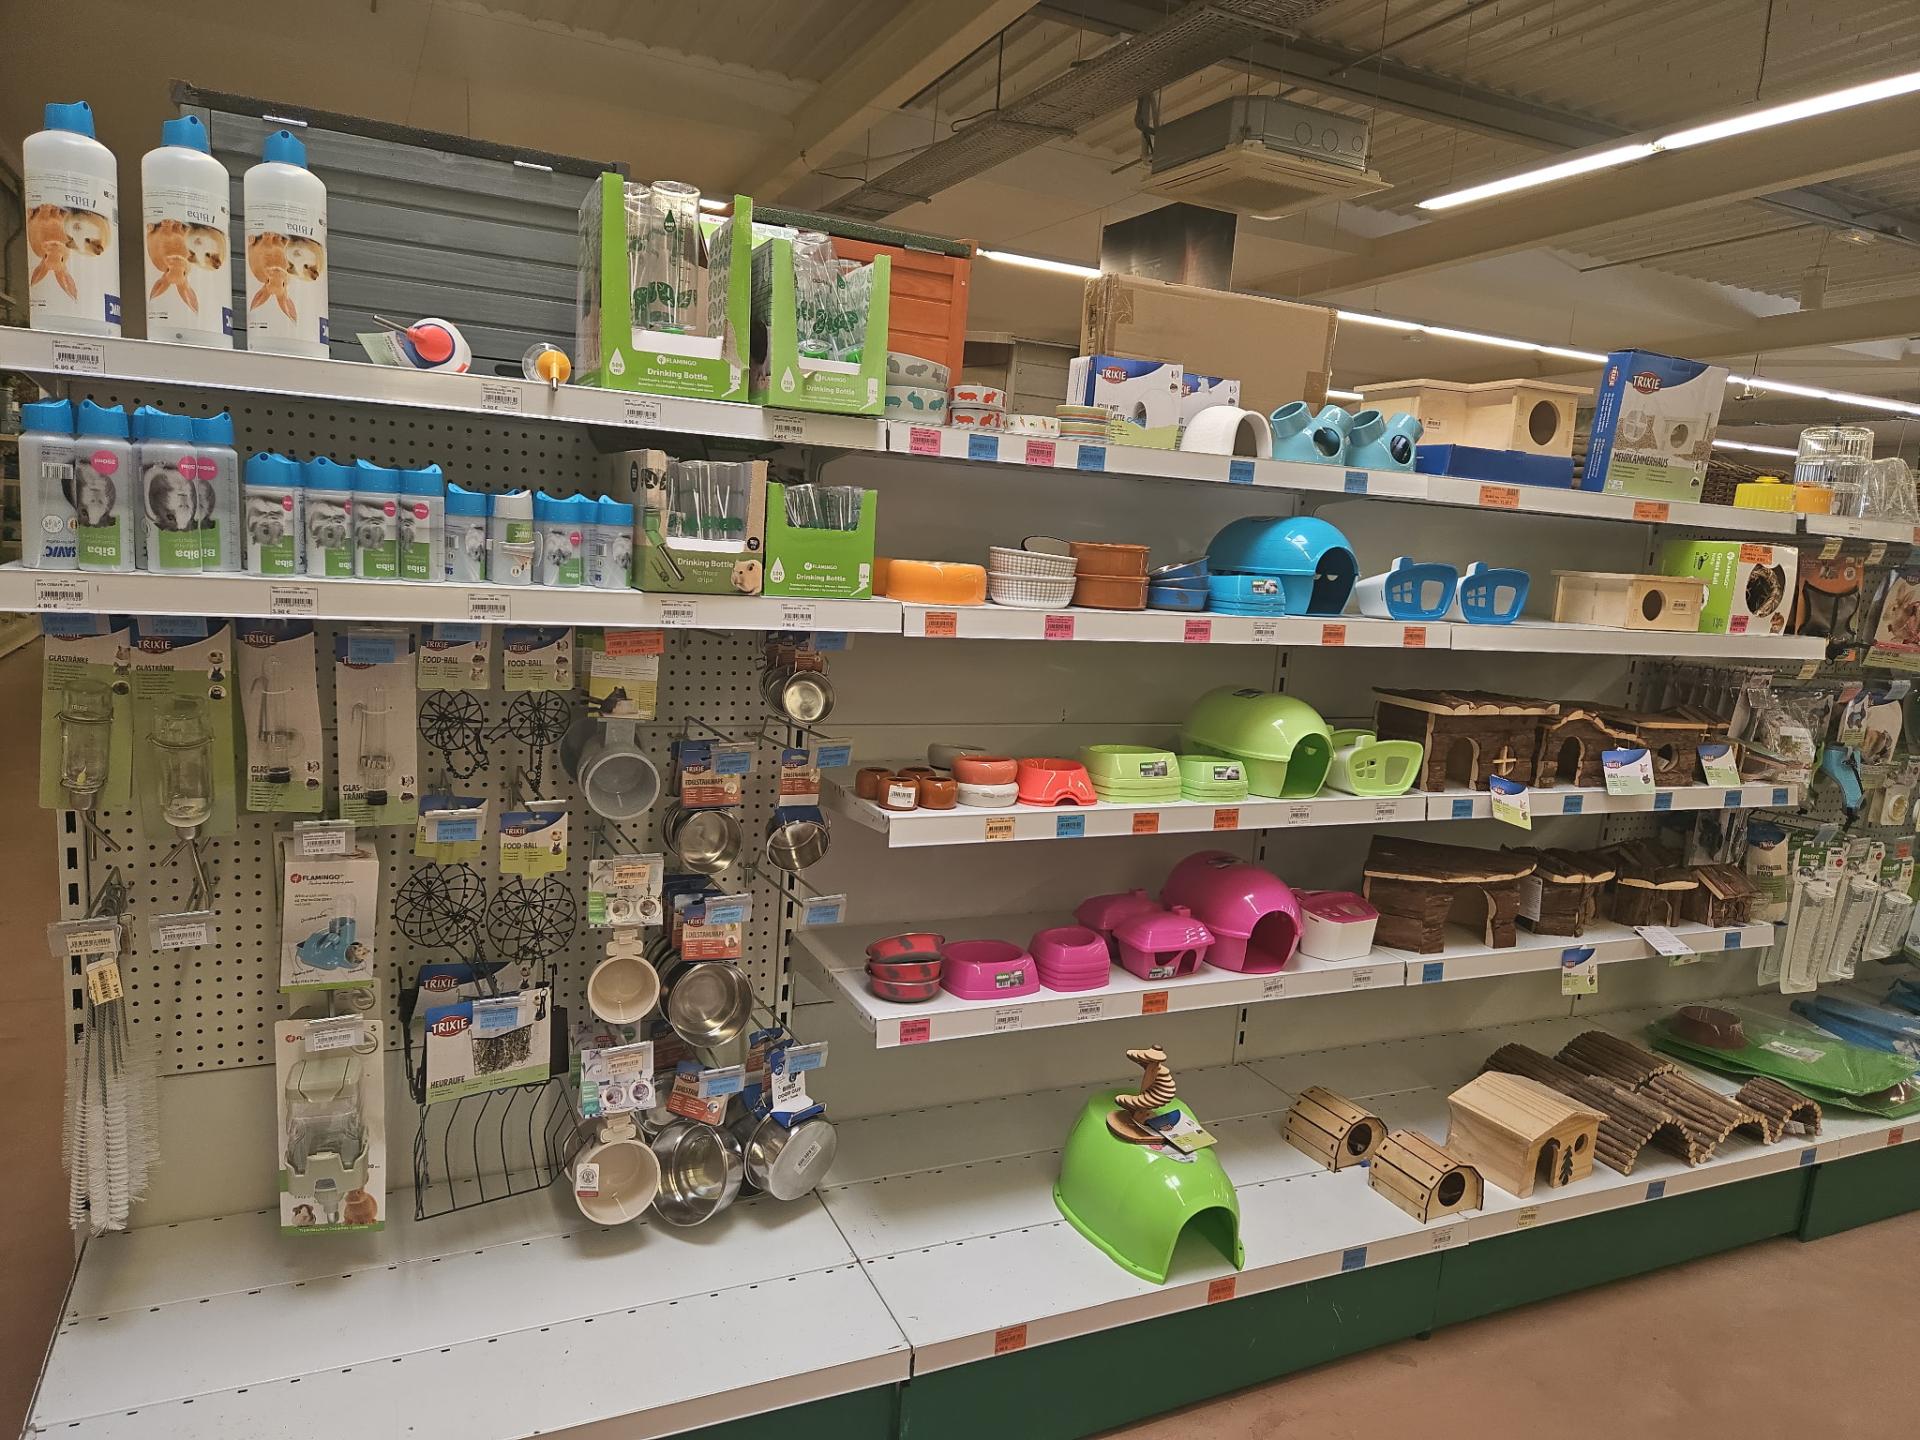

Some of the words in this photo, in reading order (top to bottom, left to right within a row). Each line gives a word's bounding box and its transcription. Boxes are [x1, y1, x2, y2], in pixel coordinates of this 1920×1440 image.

[64, 194, 89, 207] Biba
[187, 210, 209, 222] Biba
[287, 222, 308, 235] Biba
[666, 357, 697, 366] FLAMINGO
[647, 367, 682, 380] Drinking
[683, 371, 708, 381] Bottle
[1102, 369, 1127, 380] TRIXIE
[1632, 375, 1661, 390] TRIXIE
[806, 385, 835, 396] Drinking
[835, 388, 856, 396] Bottle
[1613, 452, 1669, 468] MEHRKAMMERHAUS
[87, 544, 117, 556] Biba
[406, 564, 427, 573] Biba
[677, 557, 710, 568] Drinking
[710, 560, 734, 569] Bottle
[796, 573, 825, 582] Drinking
[243, 633, 276, 644] TRIXIE
[425, 639, 450, 649] TRIXIE
[136, 639, 172, 650] TRIXIE
[508, 644, 531, 652] TRIXIE
[422, 656, 459, 664] FOOD-BALL
[507, 659, 542, 668] FOOD-BALL
[504, 827, 527, 835] TRIXIE
[302, 874, 341, 882] FLAMINGO
[423, 978, 459, 989] TRIXIE
[370, 1024, 377, 1032] S
[431, 1018, 469, 1035] TRIXIE
[430, 1074, 466, 1090] HEURAUFE
